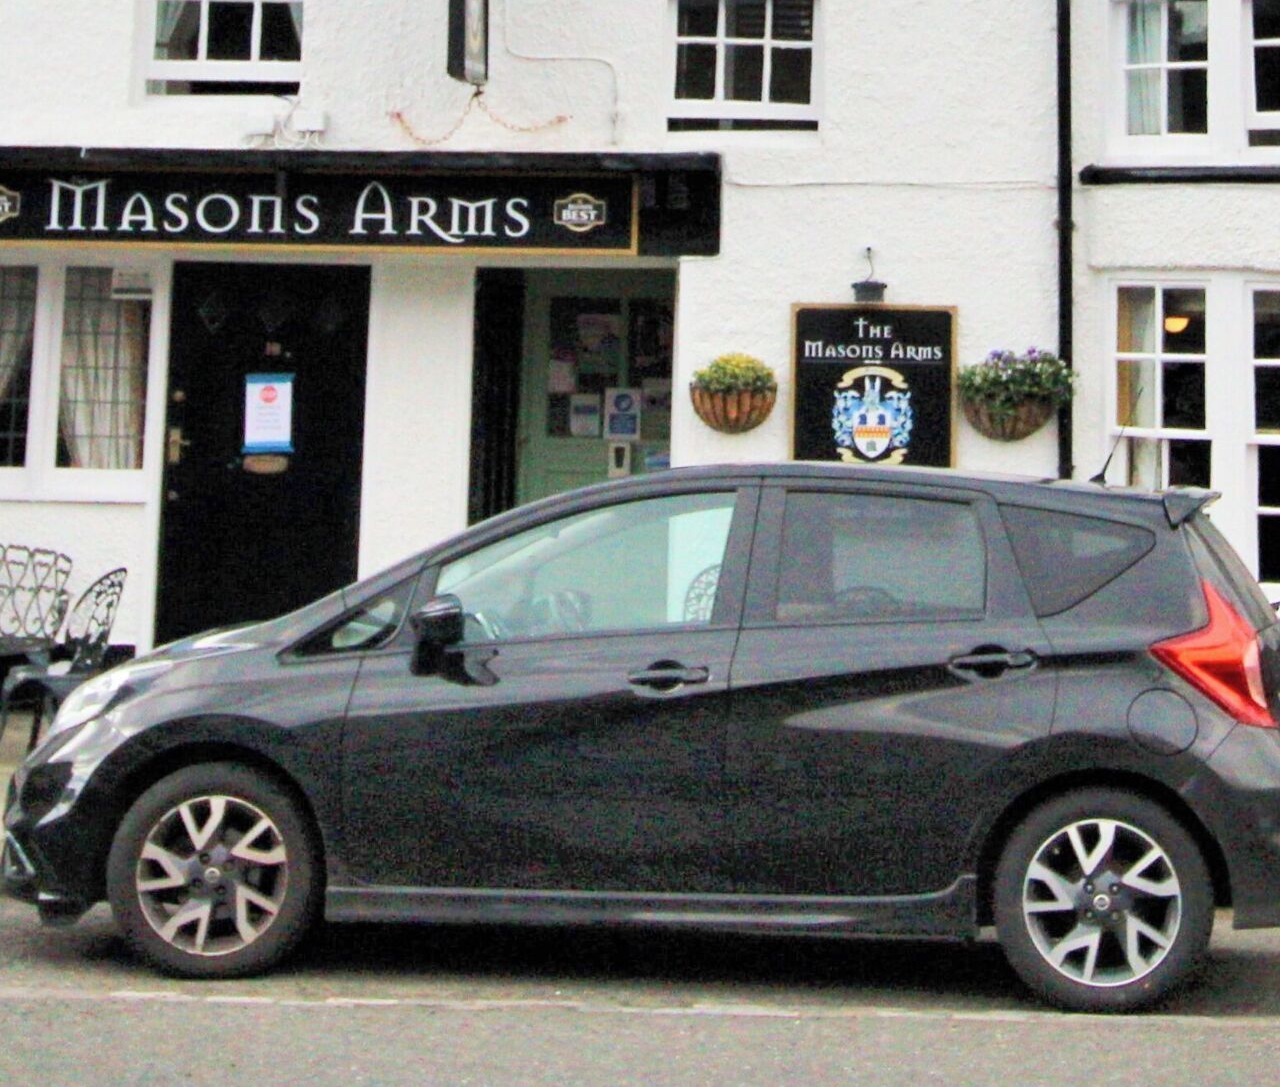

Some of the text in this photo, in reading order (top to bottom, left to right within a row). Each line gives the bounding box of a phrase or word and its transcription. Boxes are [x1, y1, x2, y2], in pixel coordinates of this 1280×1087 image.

[44, 178, 531, 244] MASONS ARMS
[853, 317, 893, 339] THE
[804, 340, 943, 361] MASONS ARMS
